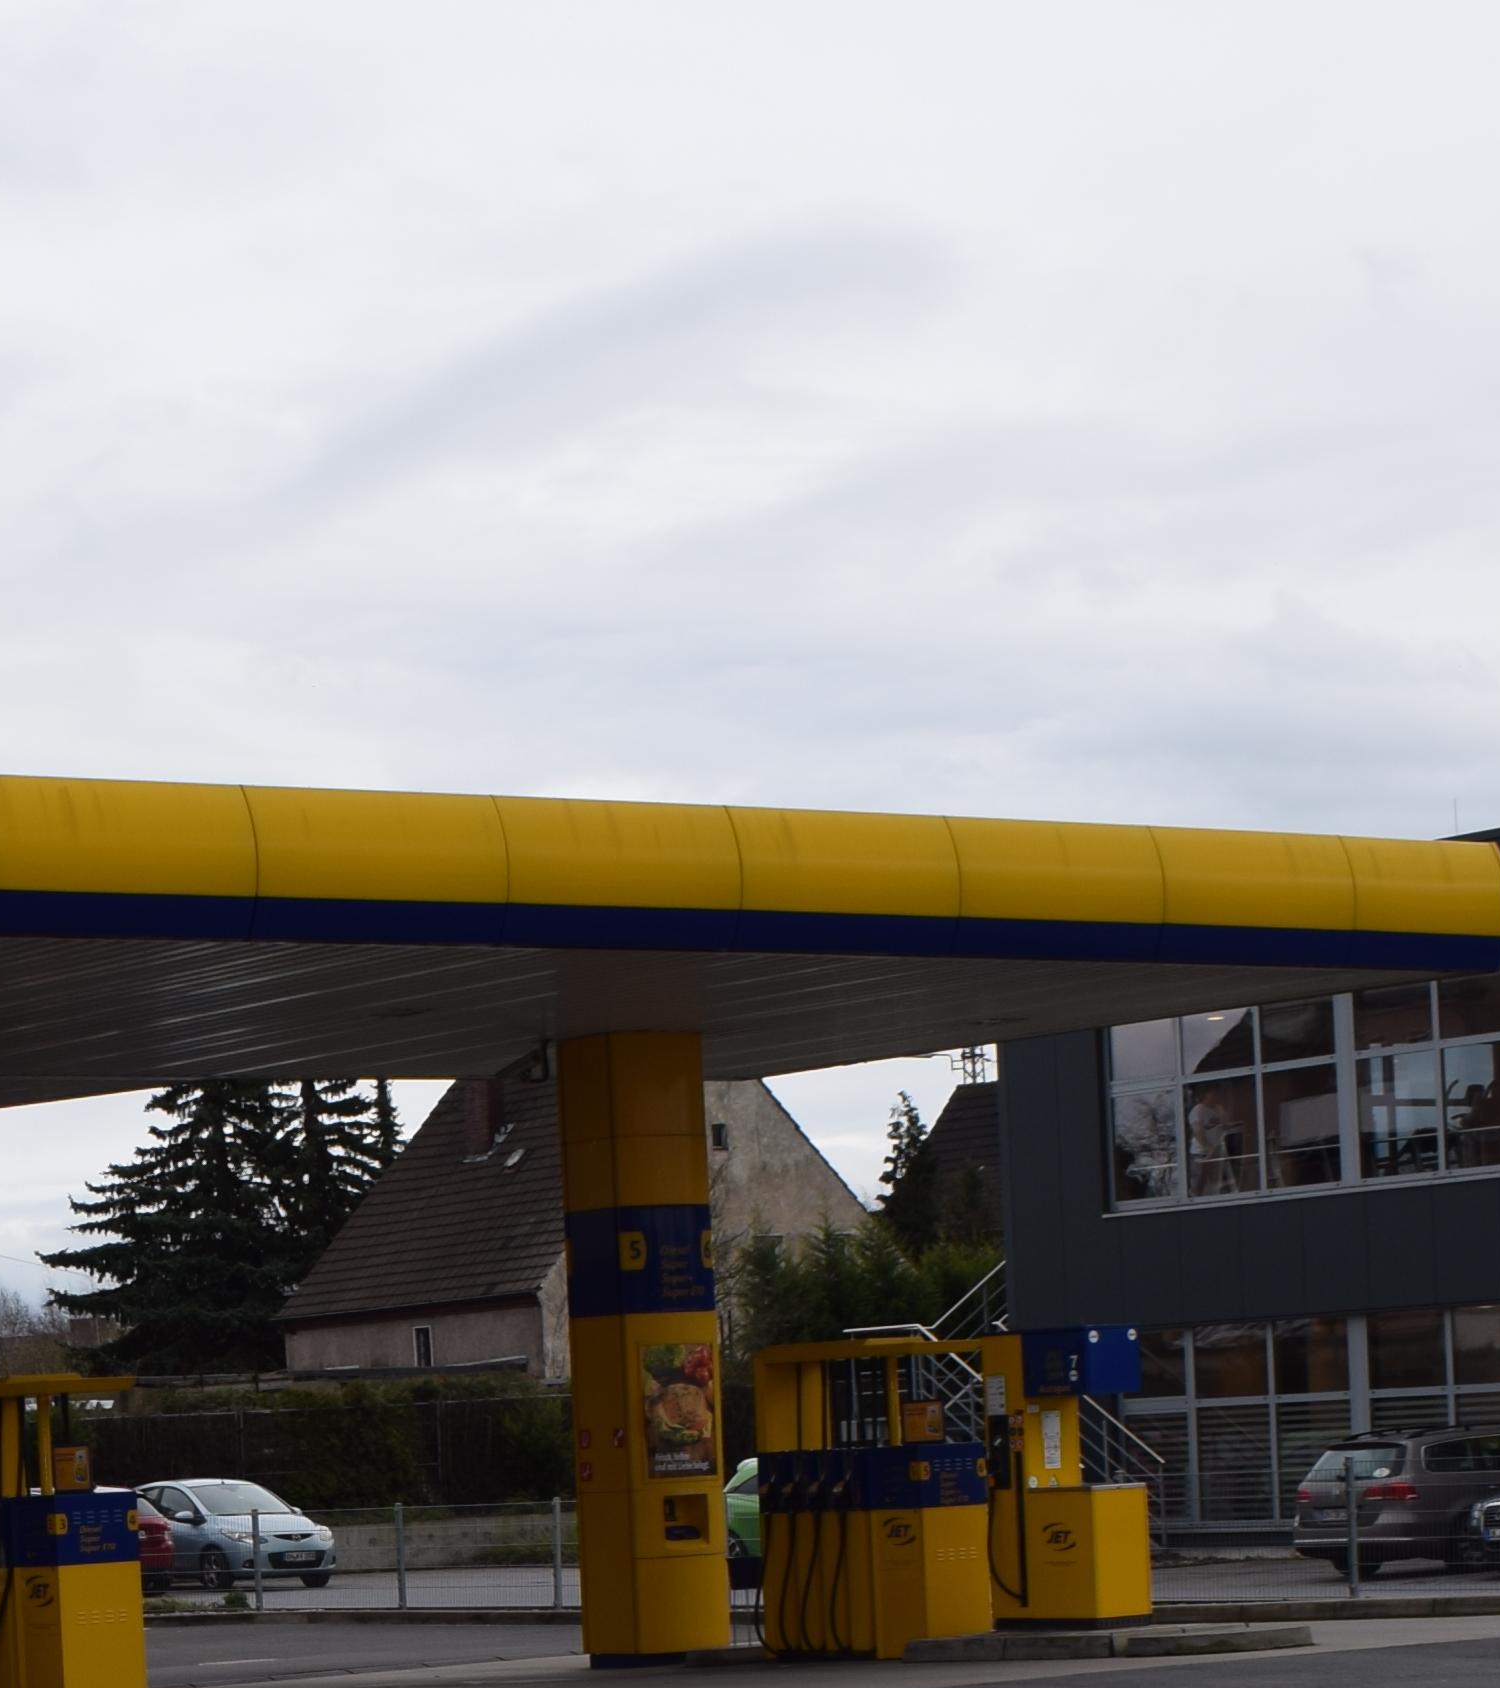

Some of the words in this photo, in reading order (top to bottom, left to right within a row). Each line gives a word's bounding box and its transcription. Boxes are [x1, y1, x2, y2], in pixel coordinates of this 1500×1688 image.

[629, 1239, 642, 1260] 5
[1068, 1354, 1079, 1369] 7
[29, 1583, 50, 1600] JET
